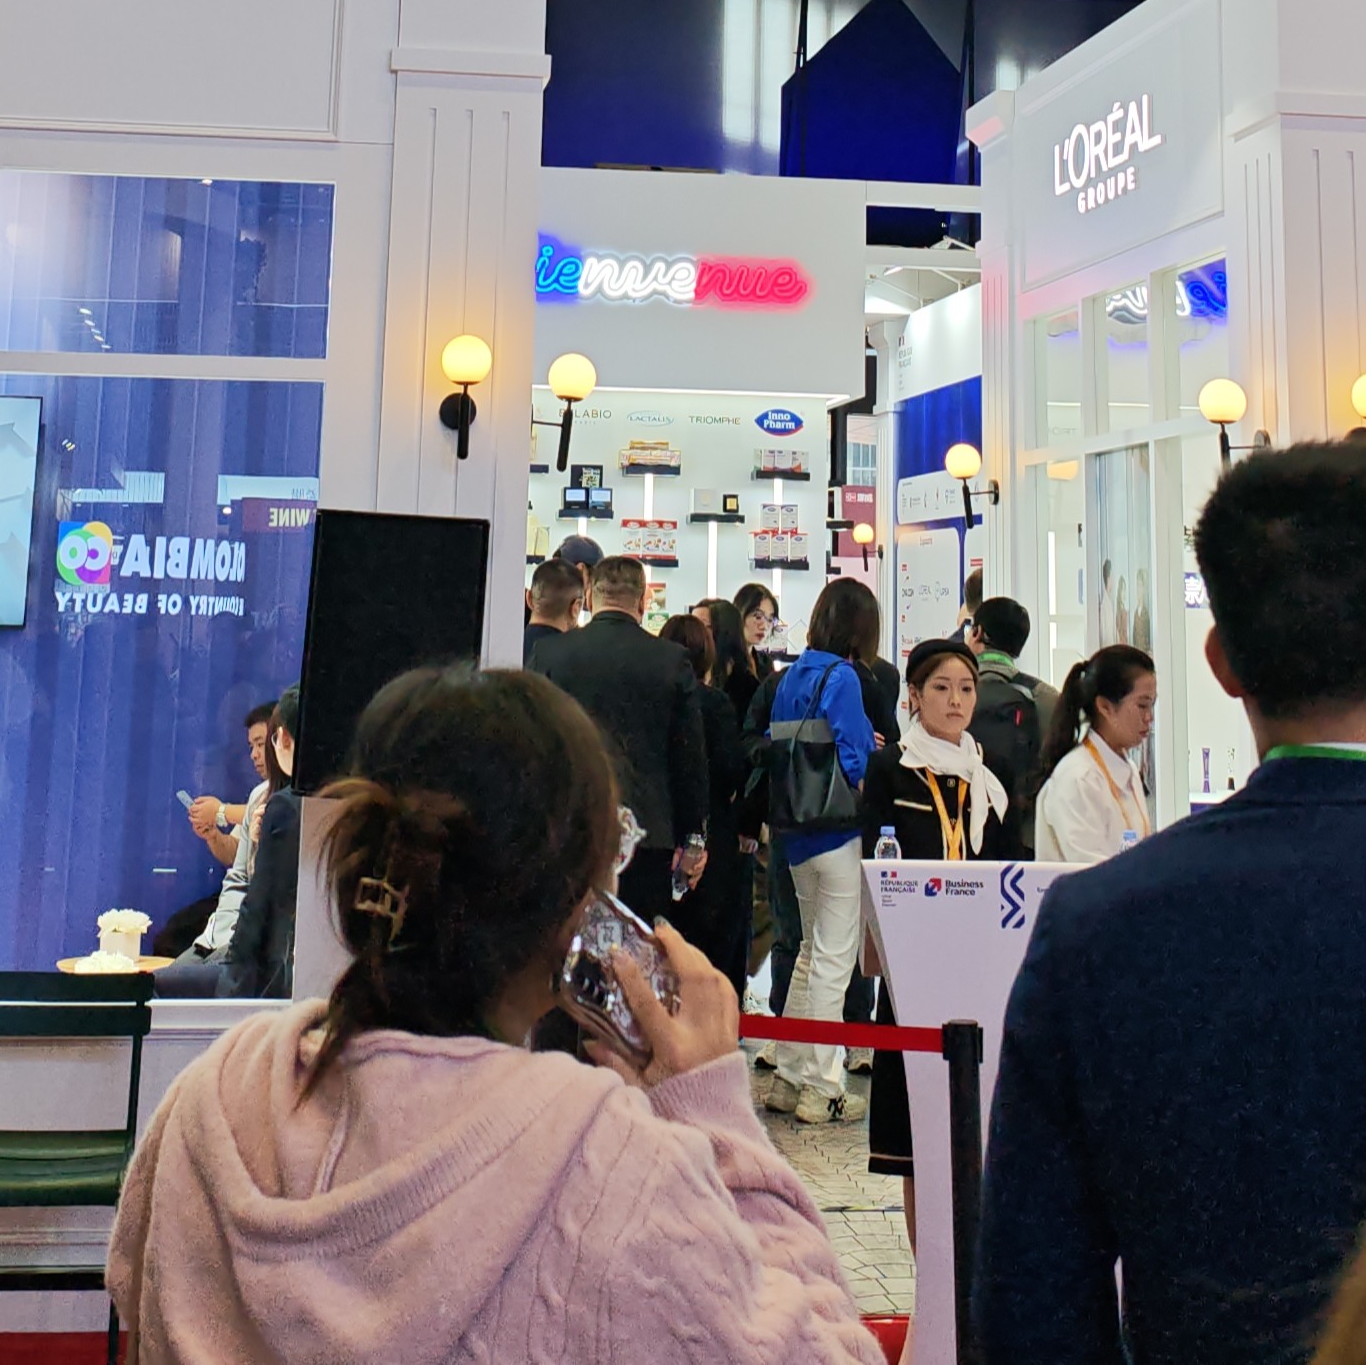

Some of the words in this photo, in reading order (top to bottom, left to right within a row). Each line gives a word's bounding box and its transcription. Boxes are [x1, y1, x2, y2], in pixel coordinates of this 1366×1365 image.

[1053, 94, 1162, 196] L'ORÉAL
[1077, 166, 1136, 213] GROUPE
[535, 245, 809, 302] ienvenue
[768, 411, 791, 421] Inno
[763, 420, 796, 430] Pharm
[945, 878, 984, 889] Business
[945, 887, 976, 896] France
